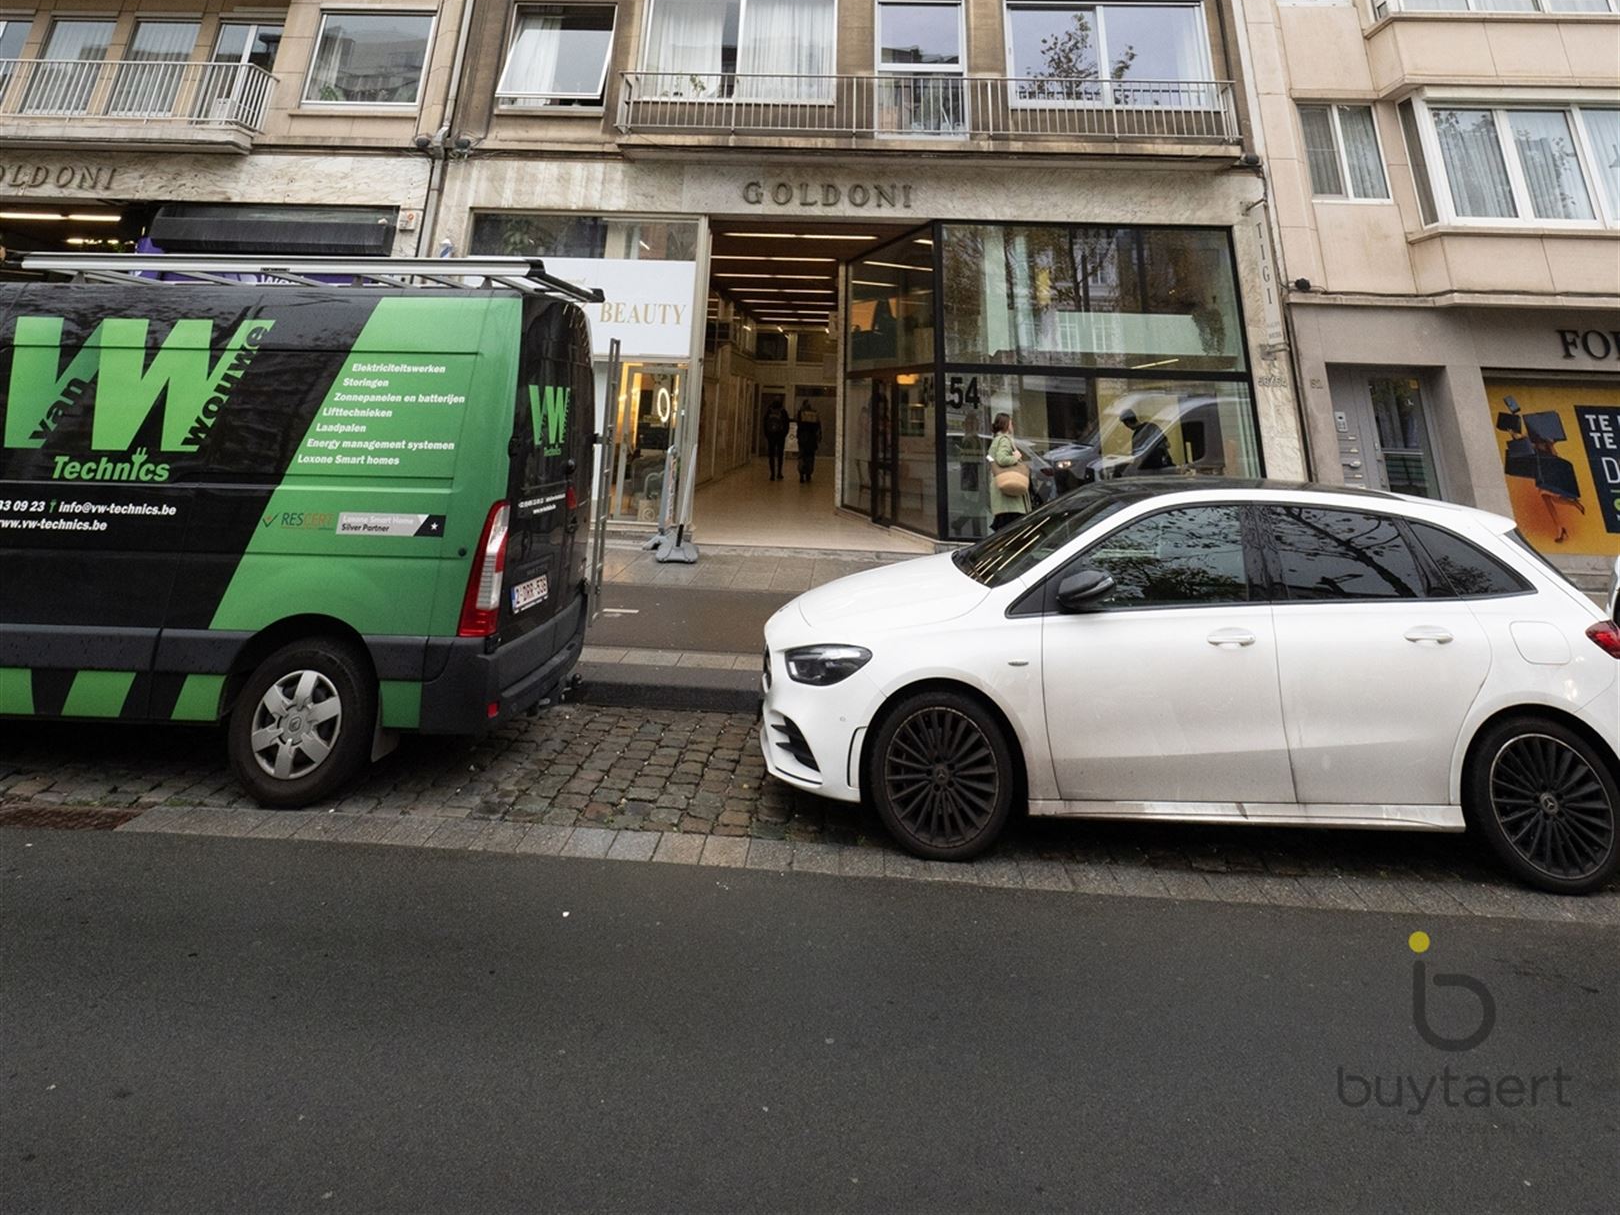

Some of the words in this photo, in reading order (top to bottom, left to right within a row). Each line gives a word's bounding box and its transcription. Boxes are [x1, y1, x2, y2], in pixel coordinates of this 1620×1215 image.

[742, 180, 912, 208] GOLDONI
[599, 301, 687, 325] BEAUTY
[1555, 329, 1620, 361] FO
[352, 363, 446, 374] Elektriciteitswerken
[343, 377, 389, 389] Storingen
[333, 392, 402, 403] Zonnepanelen
[418, 394, 466, 405] batterijen
[945, 376, 980, 409] 54
[322, 407, 393, 418] Lifttechnieken
[316, 423, 367, 434] Laadpalen
[1585, 414, 1612, 431] TE
[306, 438, 340, 450] Energy
[342, 439, 406, 450] management
[407, 440, 455, 451] systemen
[1589, 432, 1617, 449] TE
[52, 447, 170, 482] Technics
[297, 454, 333, 464] Loxone
[334, 454, 365, 464] Smart
[366, 455, 400, 465] homes
[13, 501, 29, 512] 09
[29, 501, 46, 513] 23
[58, 501, 177, 516] info@vw-technics.be
[281, 512, 334, 527] RESCERT
[341, 523, 361, 532] Silver
[362, 523, 390, 533] Partner
